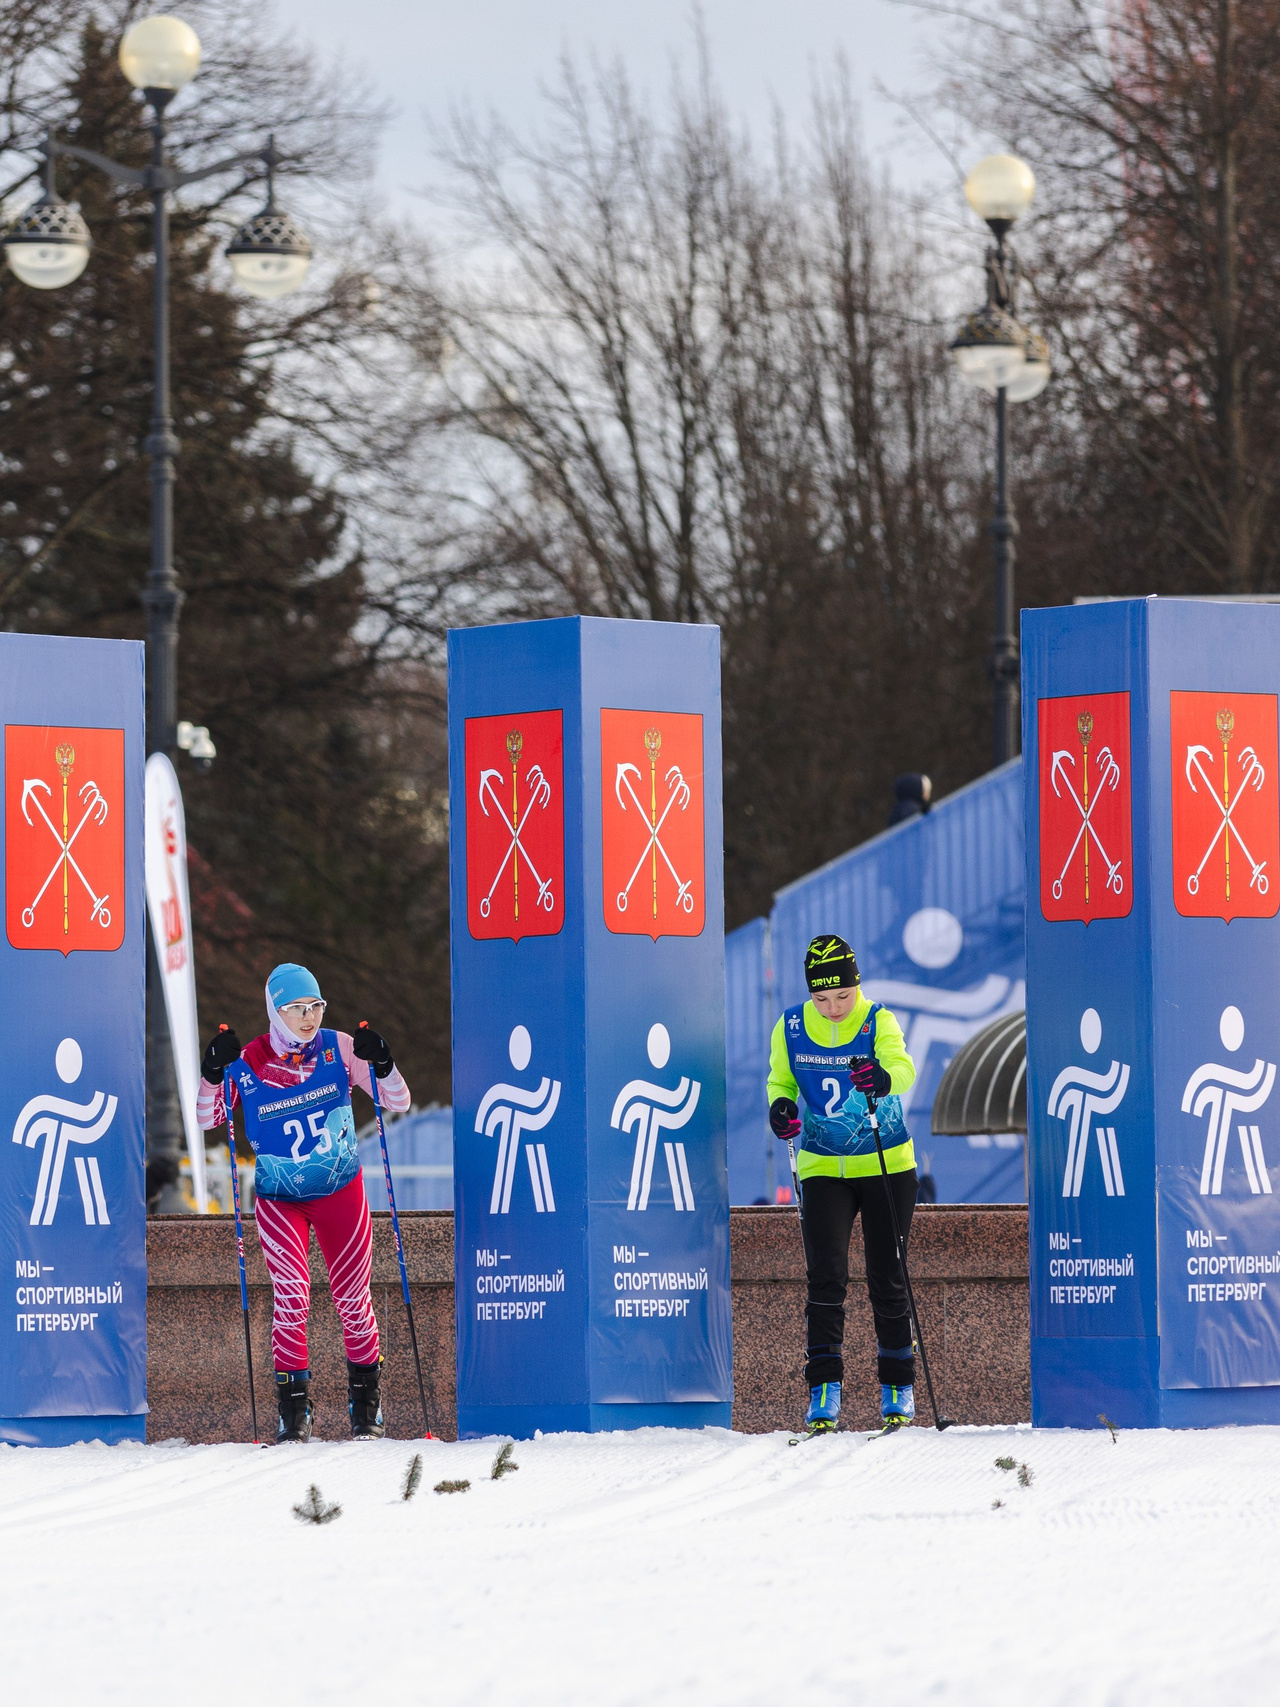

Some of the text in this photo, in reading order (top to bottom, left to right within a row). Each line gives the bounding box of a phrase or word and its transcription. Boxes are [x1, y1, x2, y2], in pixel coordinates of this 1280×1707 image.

[796, 1054, 834, 1065] ЛЫЖНЫЕ
[259, 1096, 304, 1115] ЛЫЖНЫЕ
[305, 1085, 337, 1102] ГОНКИ
[822, 1077, 845, 1118] 2
[283, 1110, 332, 1163] 25
[1050, 1254, 1133, 1277] СПОРТИВНЫЙ
[477, 1269, 564, 1293] СПОРТИВНЫЙ
[615, 1268, 707, 1290] СПОРТИВНЫЙ
[17, 1282, 122, 1304] СПОРТИВНЫЙ
[1051, 1286, 1116, 1303] ПЕТЕРБУРГ
[1189, 1283, 1266, 1301] ПЕТЕРБУРГ
[477, 1302, 546, 1320] ПЕТЕРБУРГ
[616, 1300, 689, 1317] ПЕТЕРБУРГ
[17, 1313, 98, 1331] ПЕТЕРБУРГ
